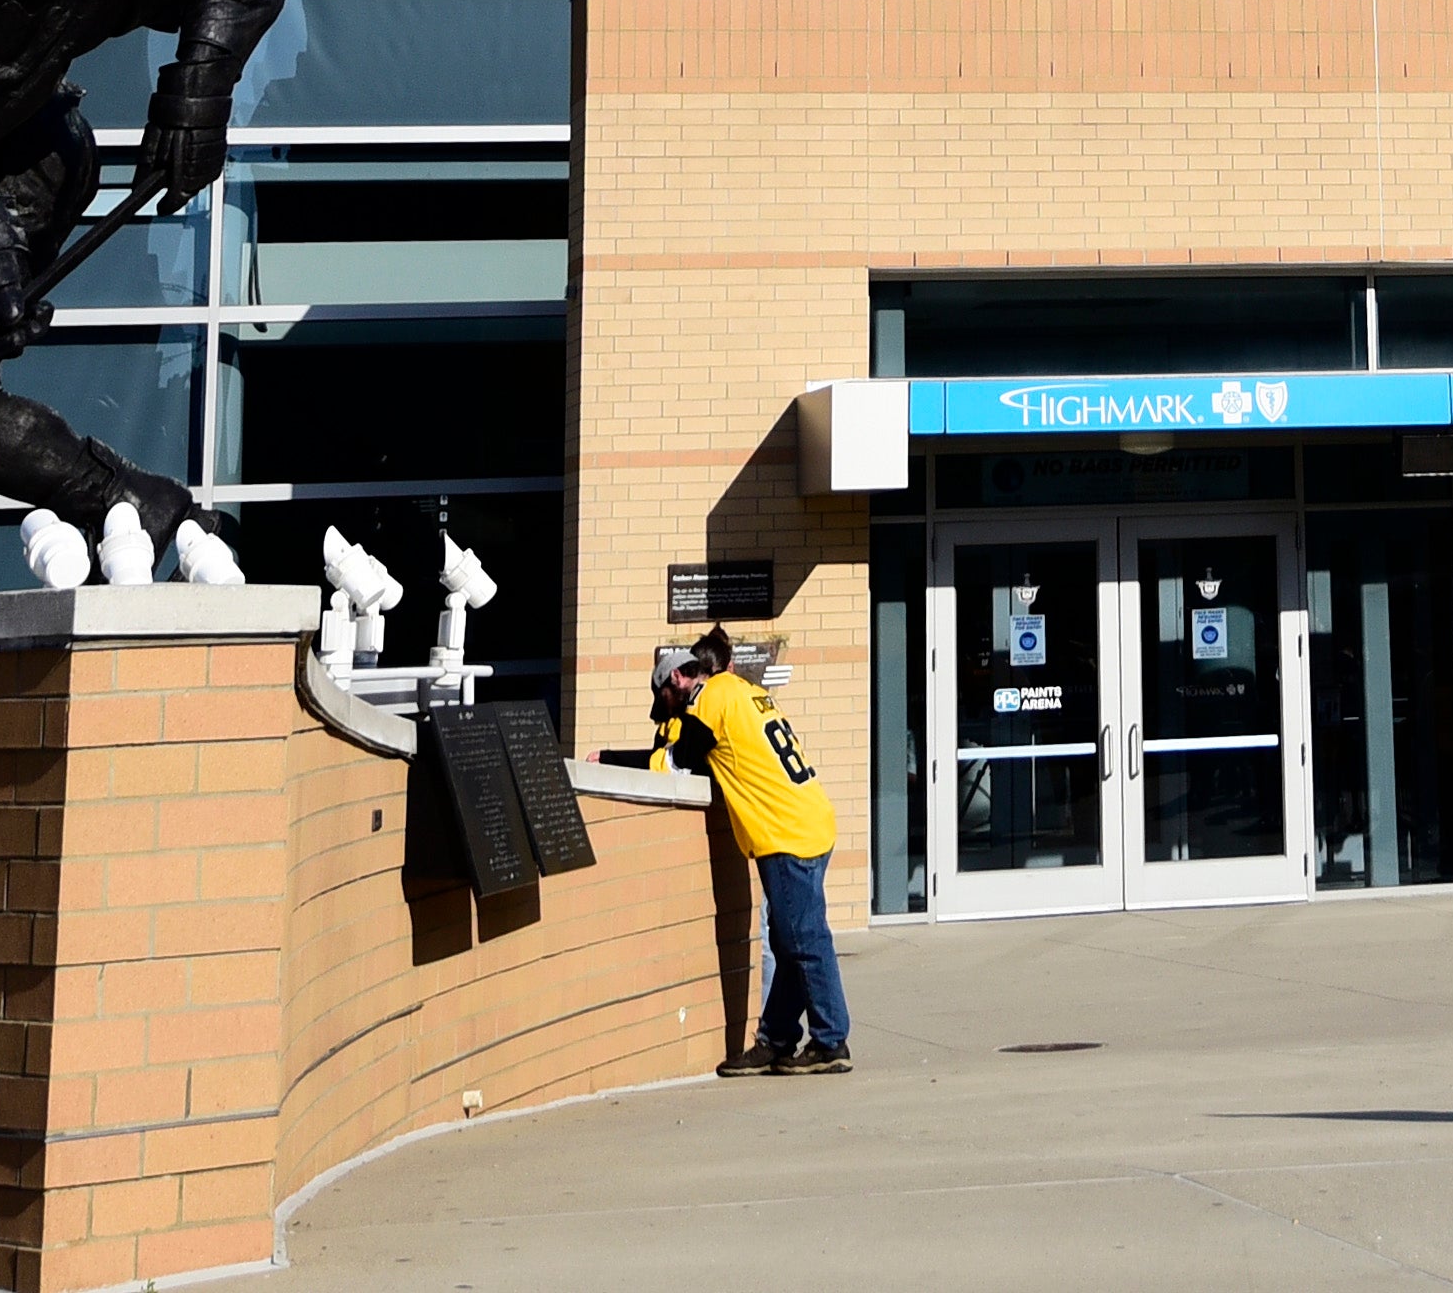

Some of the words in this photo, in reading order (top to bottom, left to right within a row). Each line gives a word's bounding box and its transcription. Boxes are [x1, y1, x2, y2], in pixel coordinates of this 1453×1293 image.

[1005, 386, 1196, 426] HIGHMARK
[994, 688, 1021, 712] PPG
[1021, 686, 1062, 699] PAINTS
[1021, 698, 1062, 711] ARENA
